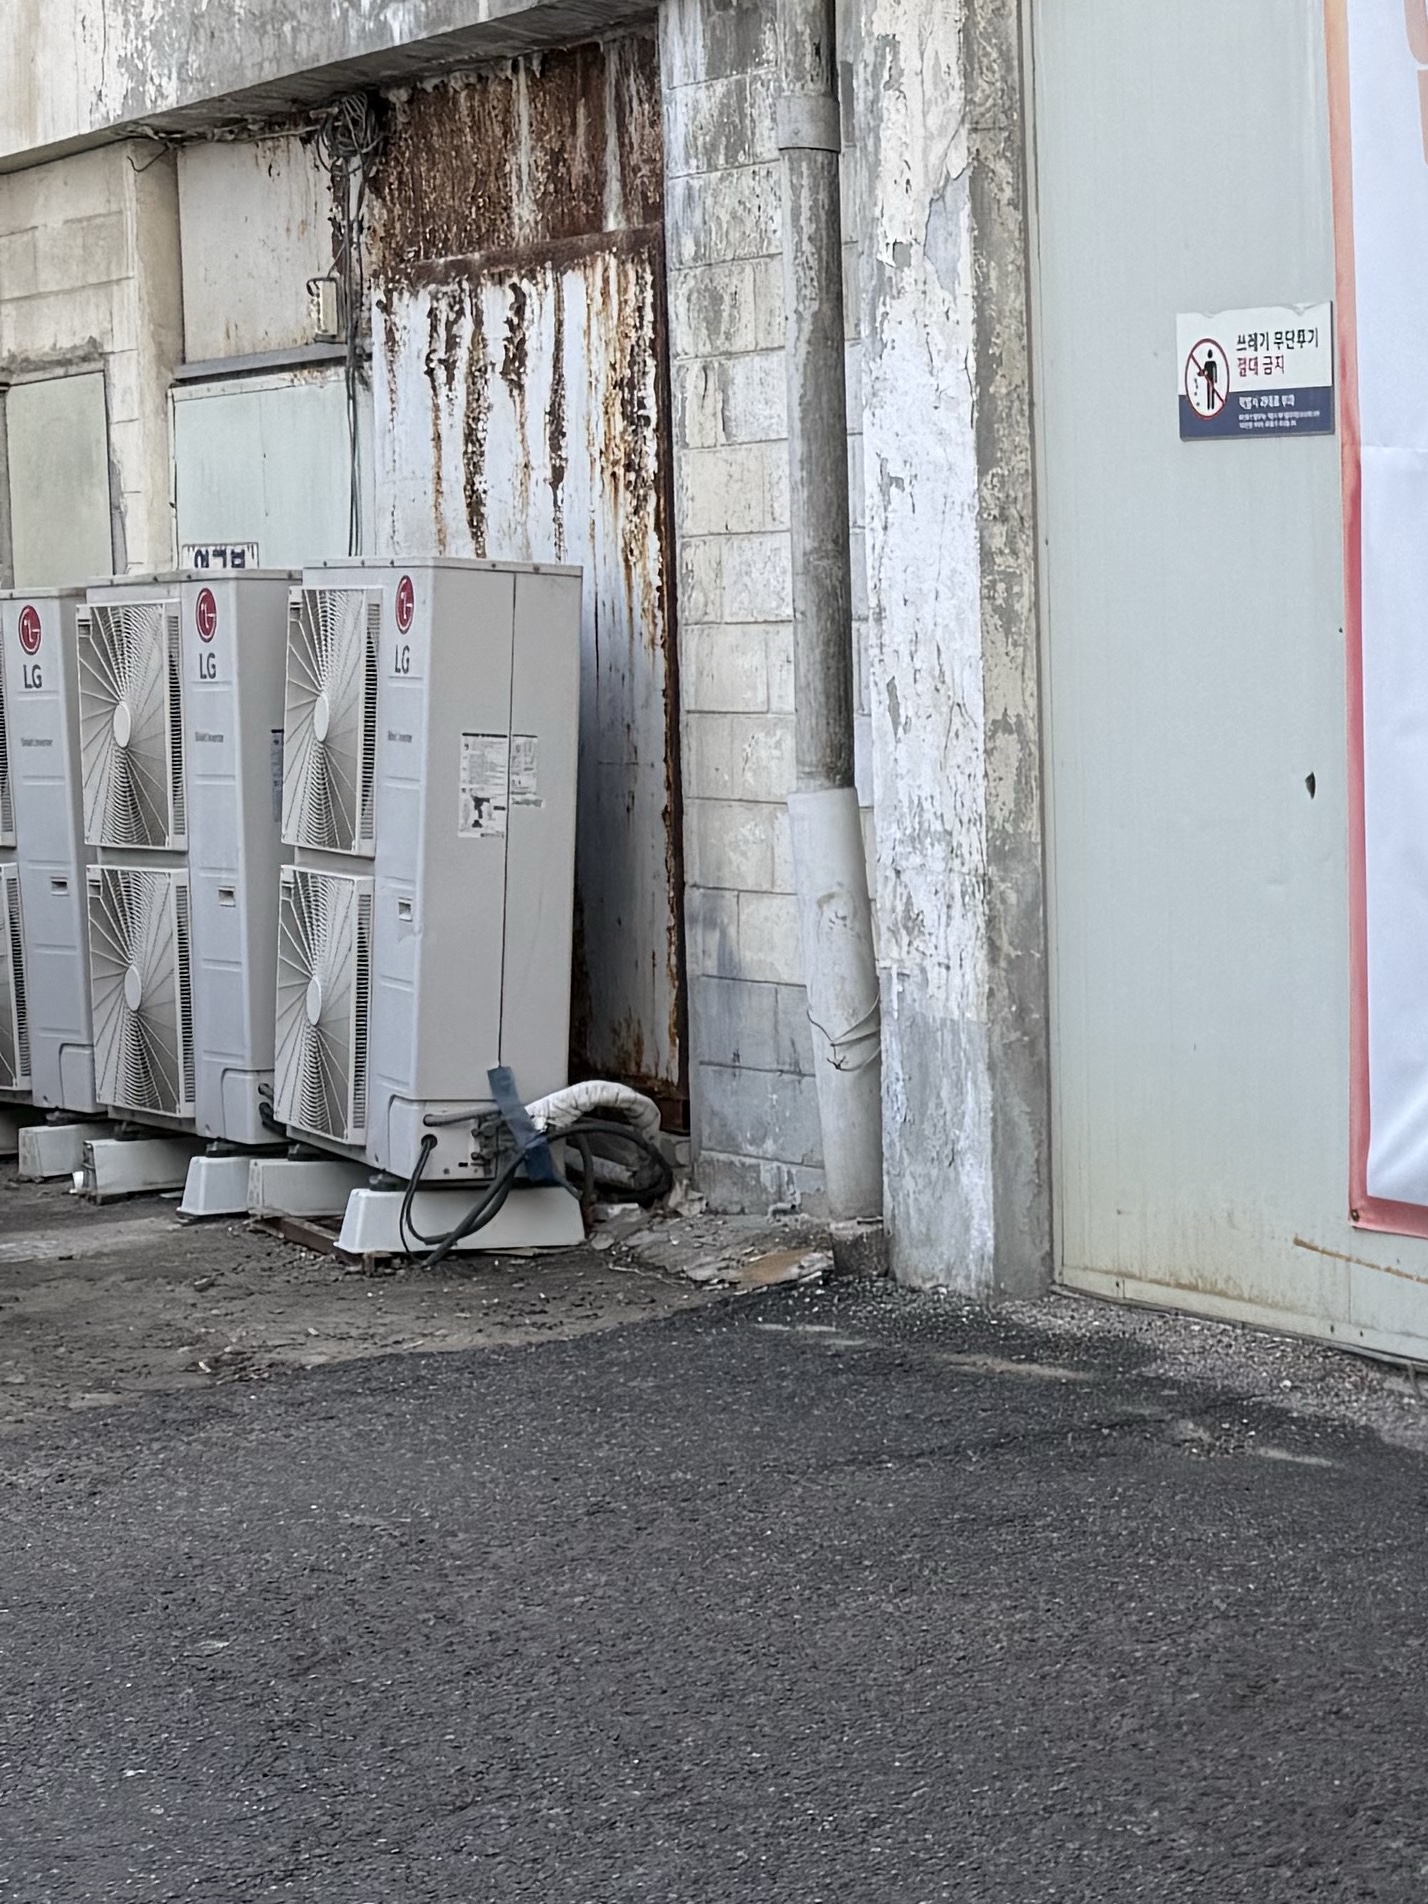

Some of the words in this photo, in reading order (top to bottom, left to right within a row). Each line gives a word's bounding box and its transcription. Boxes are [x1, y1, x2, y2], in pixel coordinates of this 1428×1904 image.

[1236, 331, 1269, 352] 쓰레기
[1274, 327, 1318, 350] 무단투기
[1262, 354, 1285, 375] 금지
[199, 652, 217, 679] LG
[395, 644, 410, 674] LG
[23, 664, 42, 689] LG
